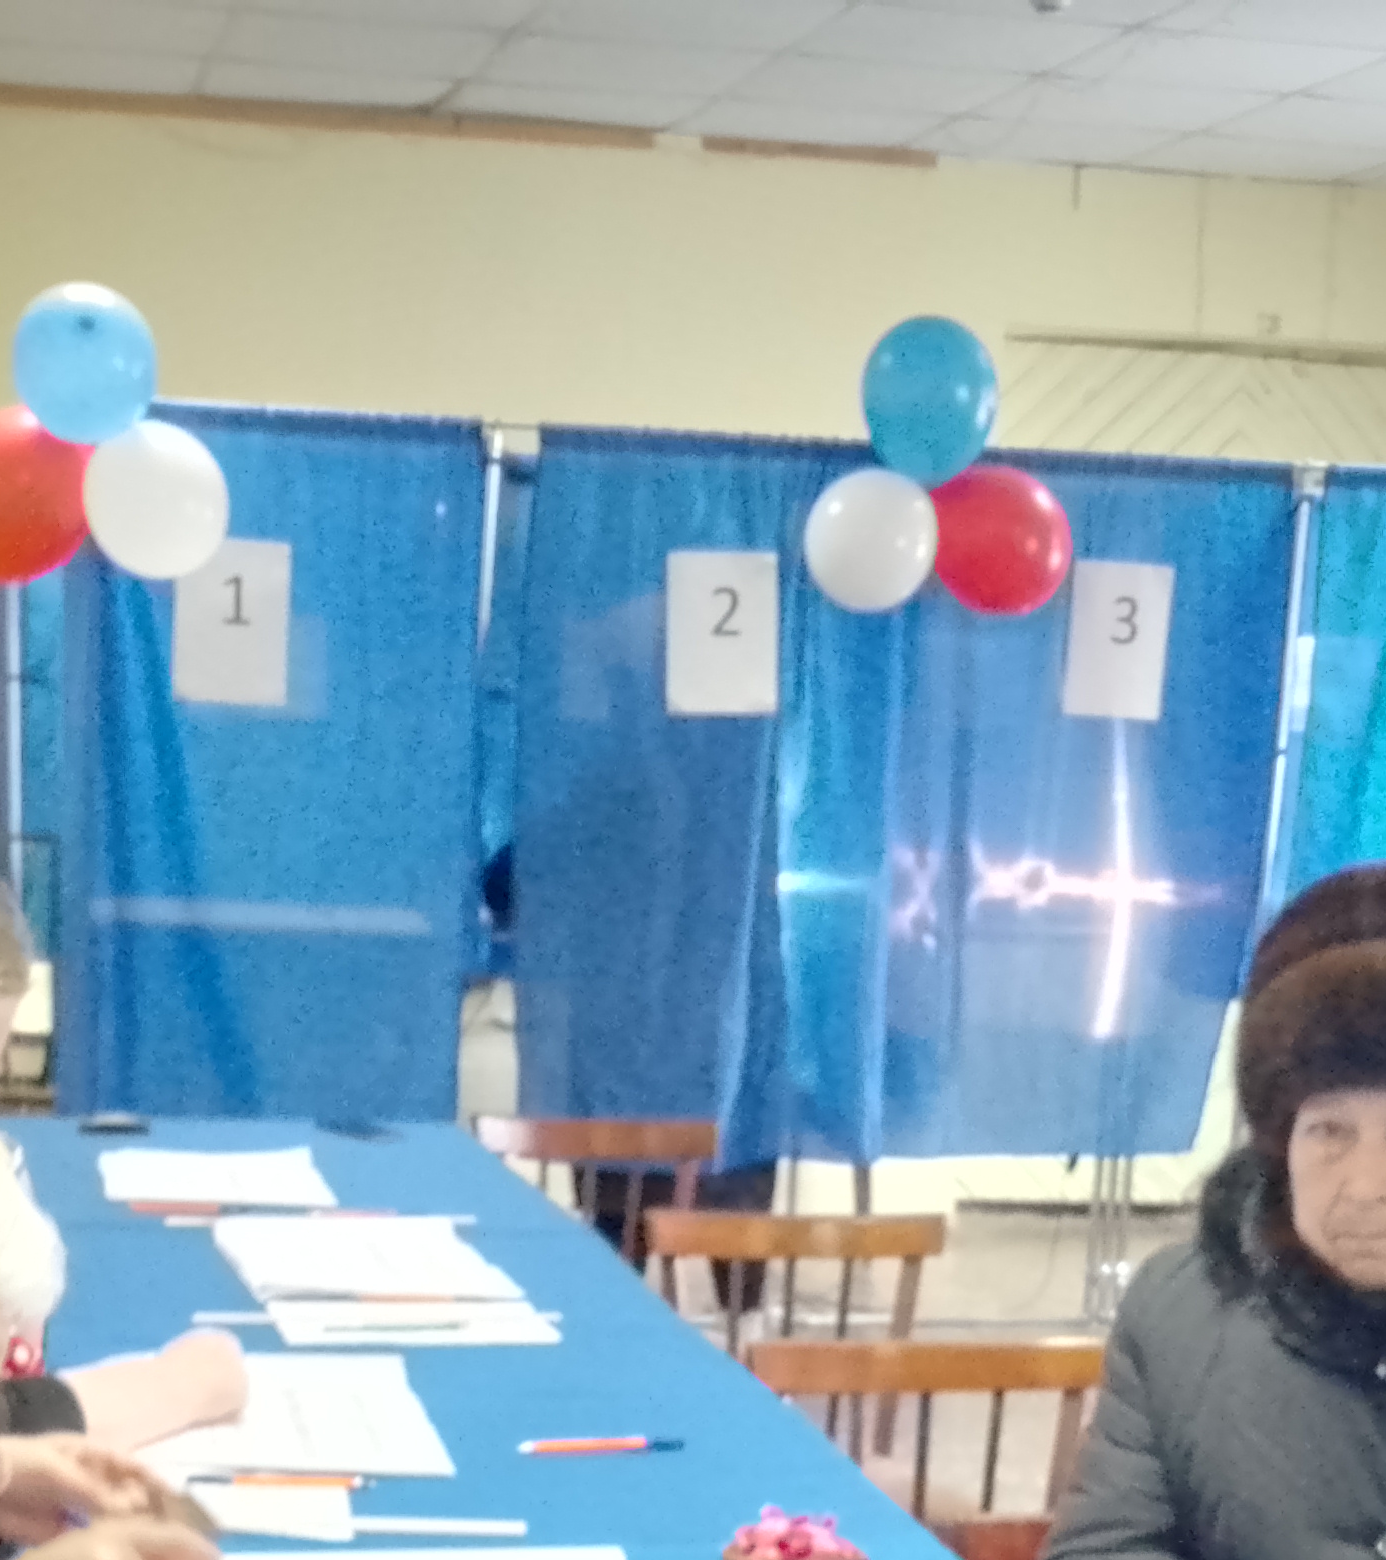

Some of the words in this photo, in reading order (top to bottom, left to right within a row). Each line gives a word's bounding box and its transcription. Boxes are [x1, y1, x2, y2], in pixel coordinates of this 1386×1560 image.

[222, 573, 251, 626] 1
[712, 585, 742, 637] 2
[1111, 596, 1138, 645] 3
